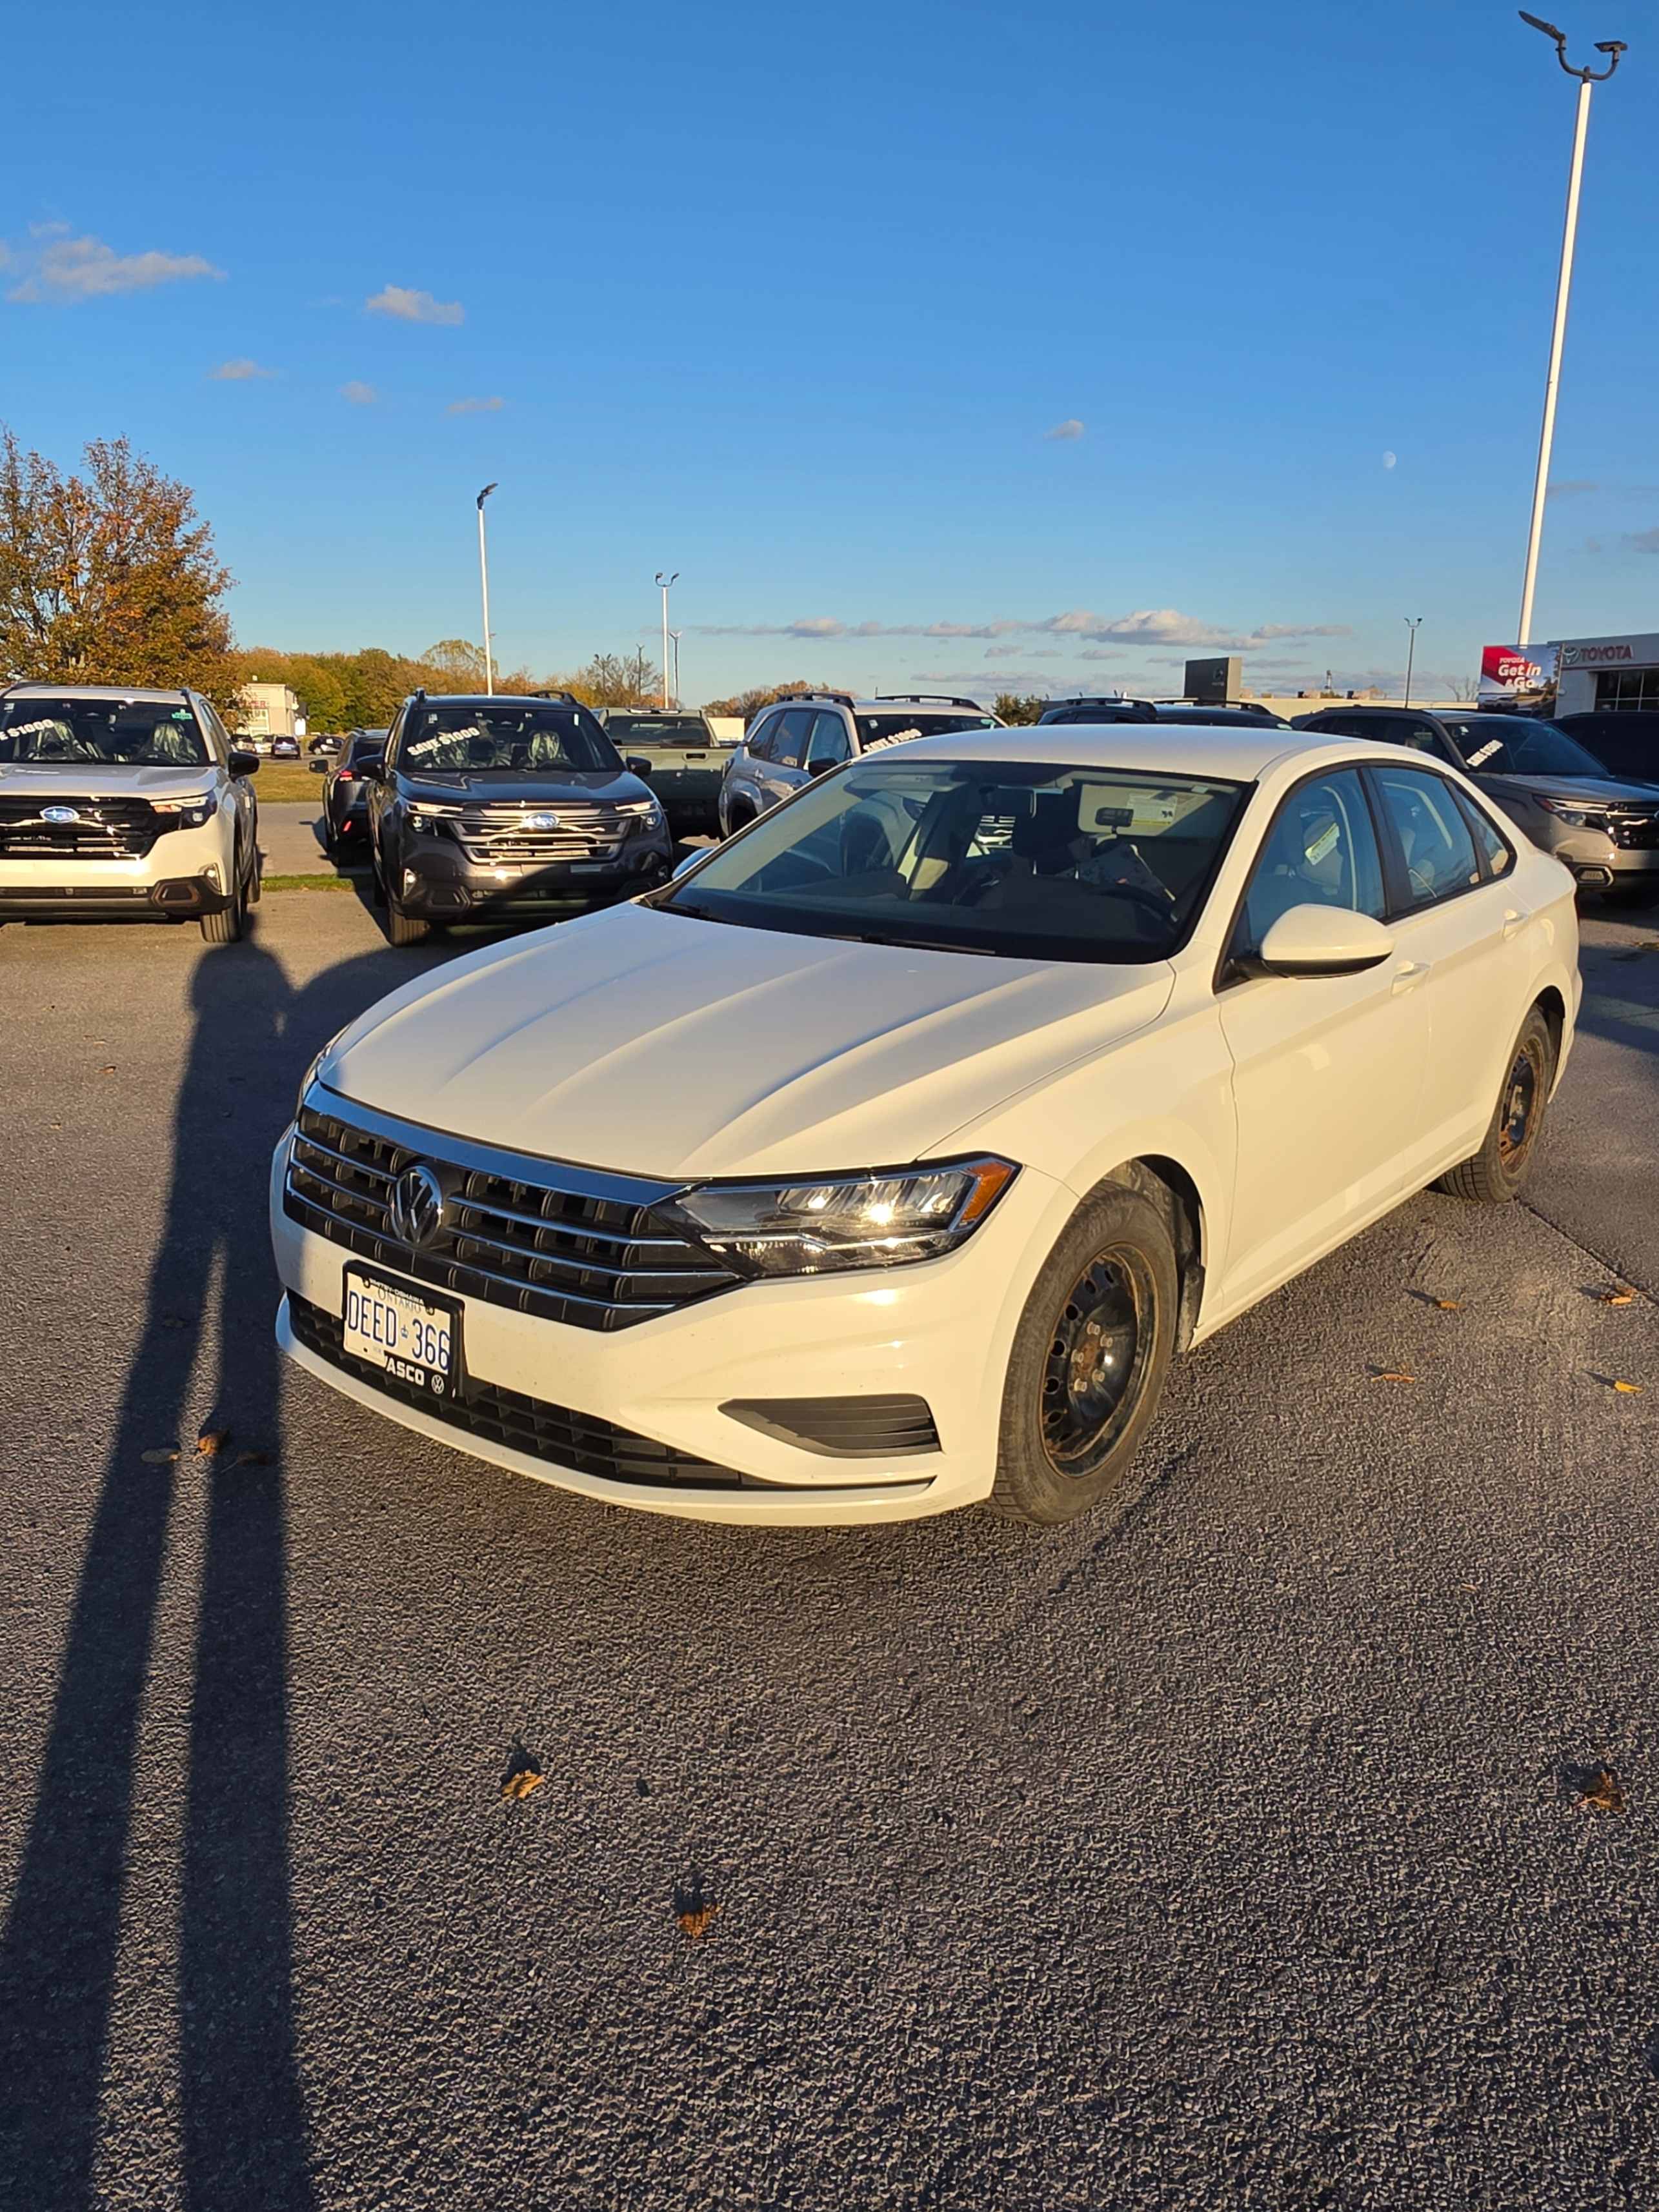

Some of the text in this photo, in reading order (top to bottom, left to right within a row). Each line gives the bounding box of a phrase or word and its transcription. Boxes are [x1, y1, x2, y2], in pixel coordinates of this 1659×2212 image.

[1581, 645, 1632, 662] TOYOTA
[1498, 664, 1525, 677] Get
[1514, 677, 1535, 688] Go
[378, 1289, 421, 1313] ONTARIO
[348, 1291, 450, 1370] DEED 366
[385, 1356, 425, 1386] ASCO
